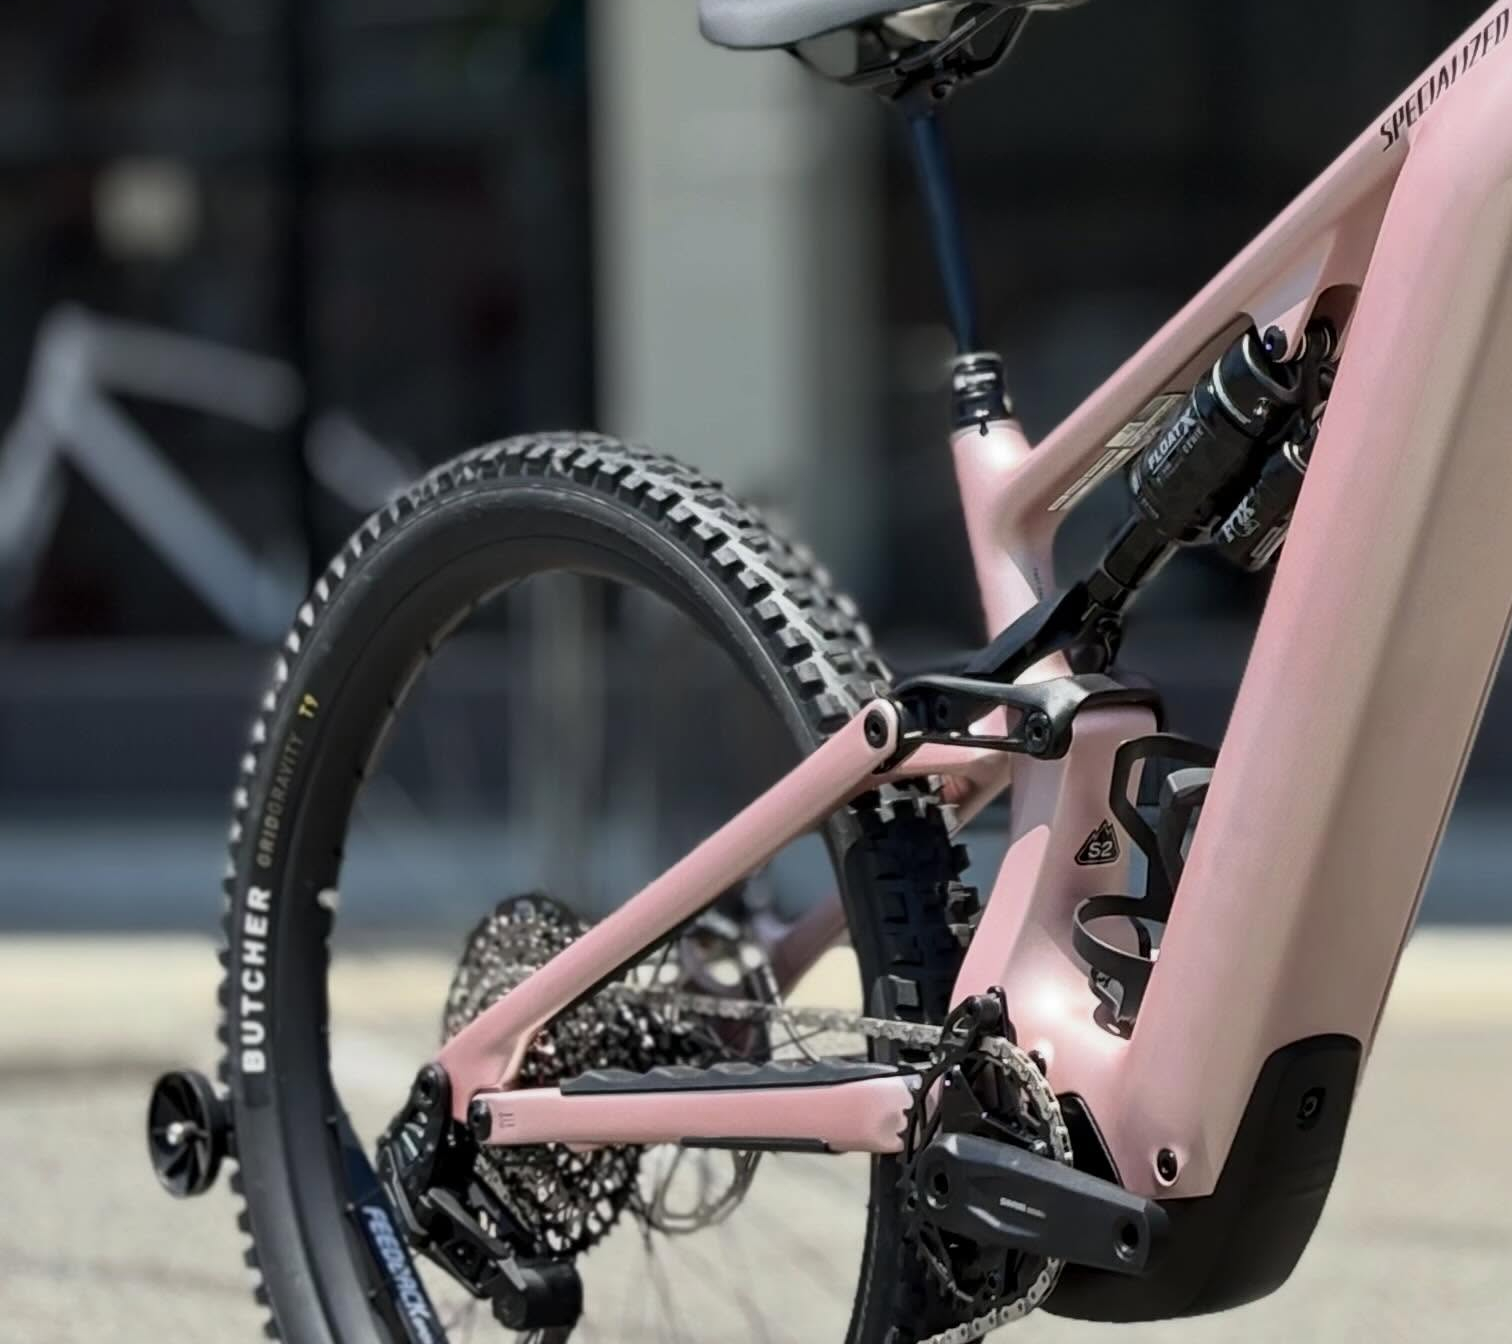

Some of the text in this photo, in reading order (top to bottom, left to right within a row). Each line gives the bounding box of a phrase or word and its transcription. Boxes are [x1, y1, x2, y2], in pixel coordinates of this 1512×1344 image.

[1380, 8, 1510, 153] SPECIALIZED
[239, 885, 272, 1073] BUTCHER
[298, 693, 319, 719] T9
[1087, 841, 1113, 858] S2
